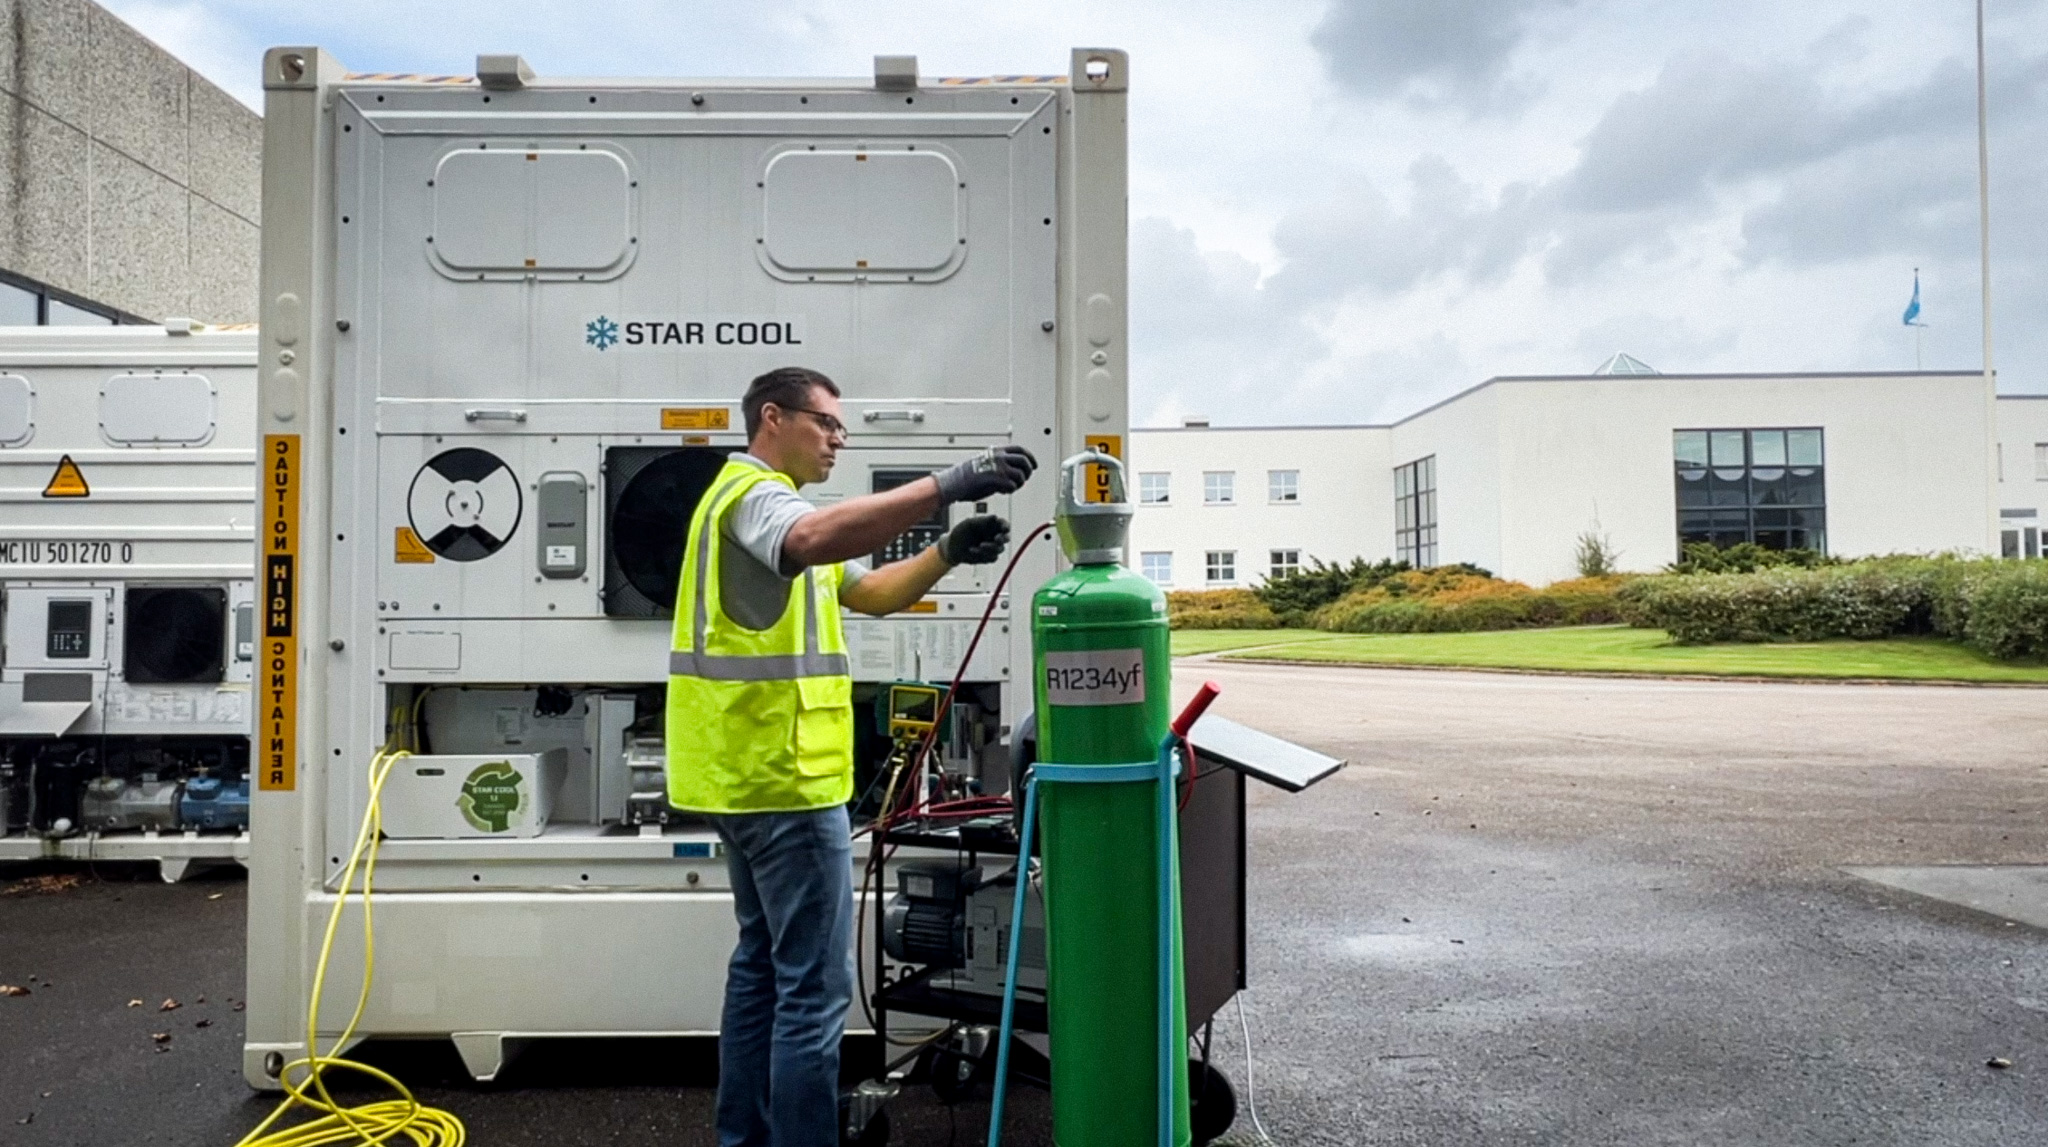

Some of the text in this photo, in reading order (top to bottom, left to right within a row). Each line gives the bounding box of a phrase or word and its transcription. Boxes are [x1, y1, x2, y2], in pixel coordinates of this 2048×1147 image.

[626, 322, 802, 345] STAR COOL
[0, 542, 132, 563] MCIU 501270 0
[1047, 663, 1141, 694] R1234yf
